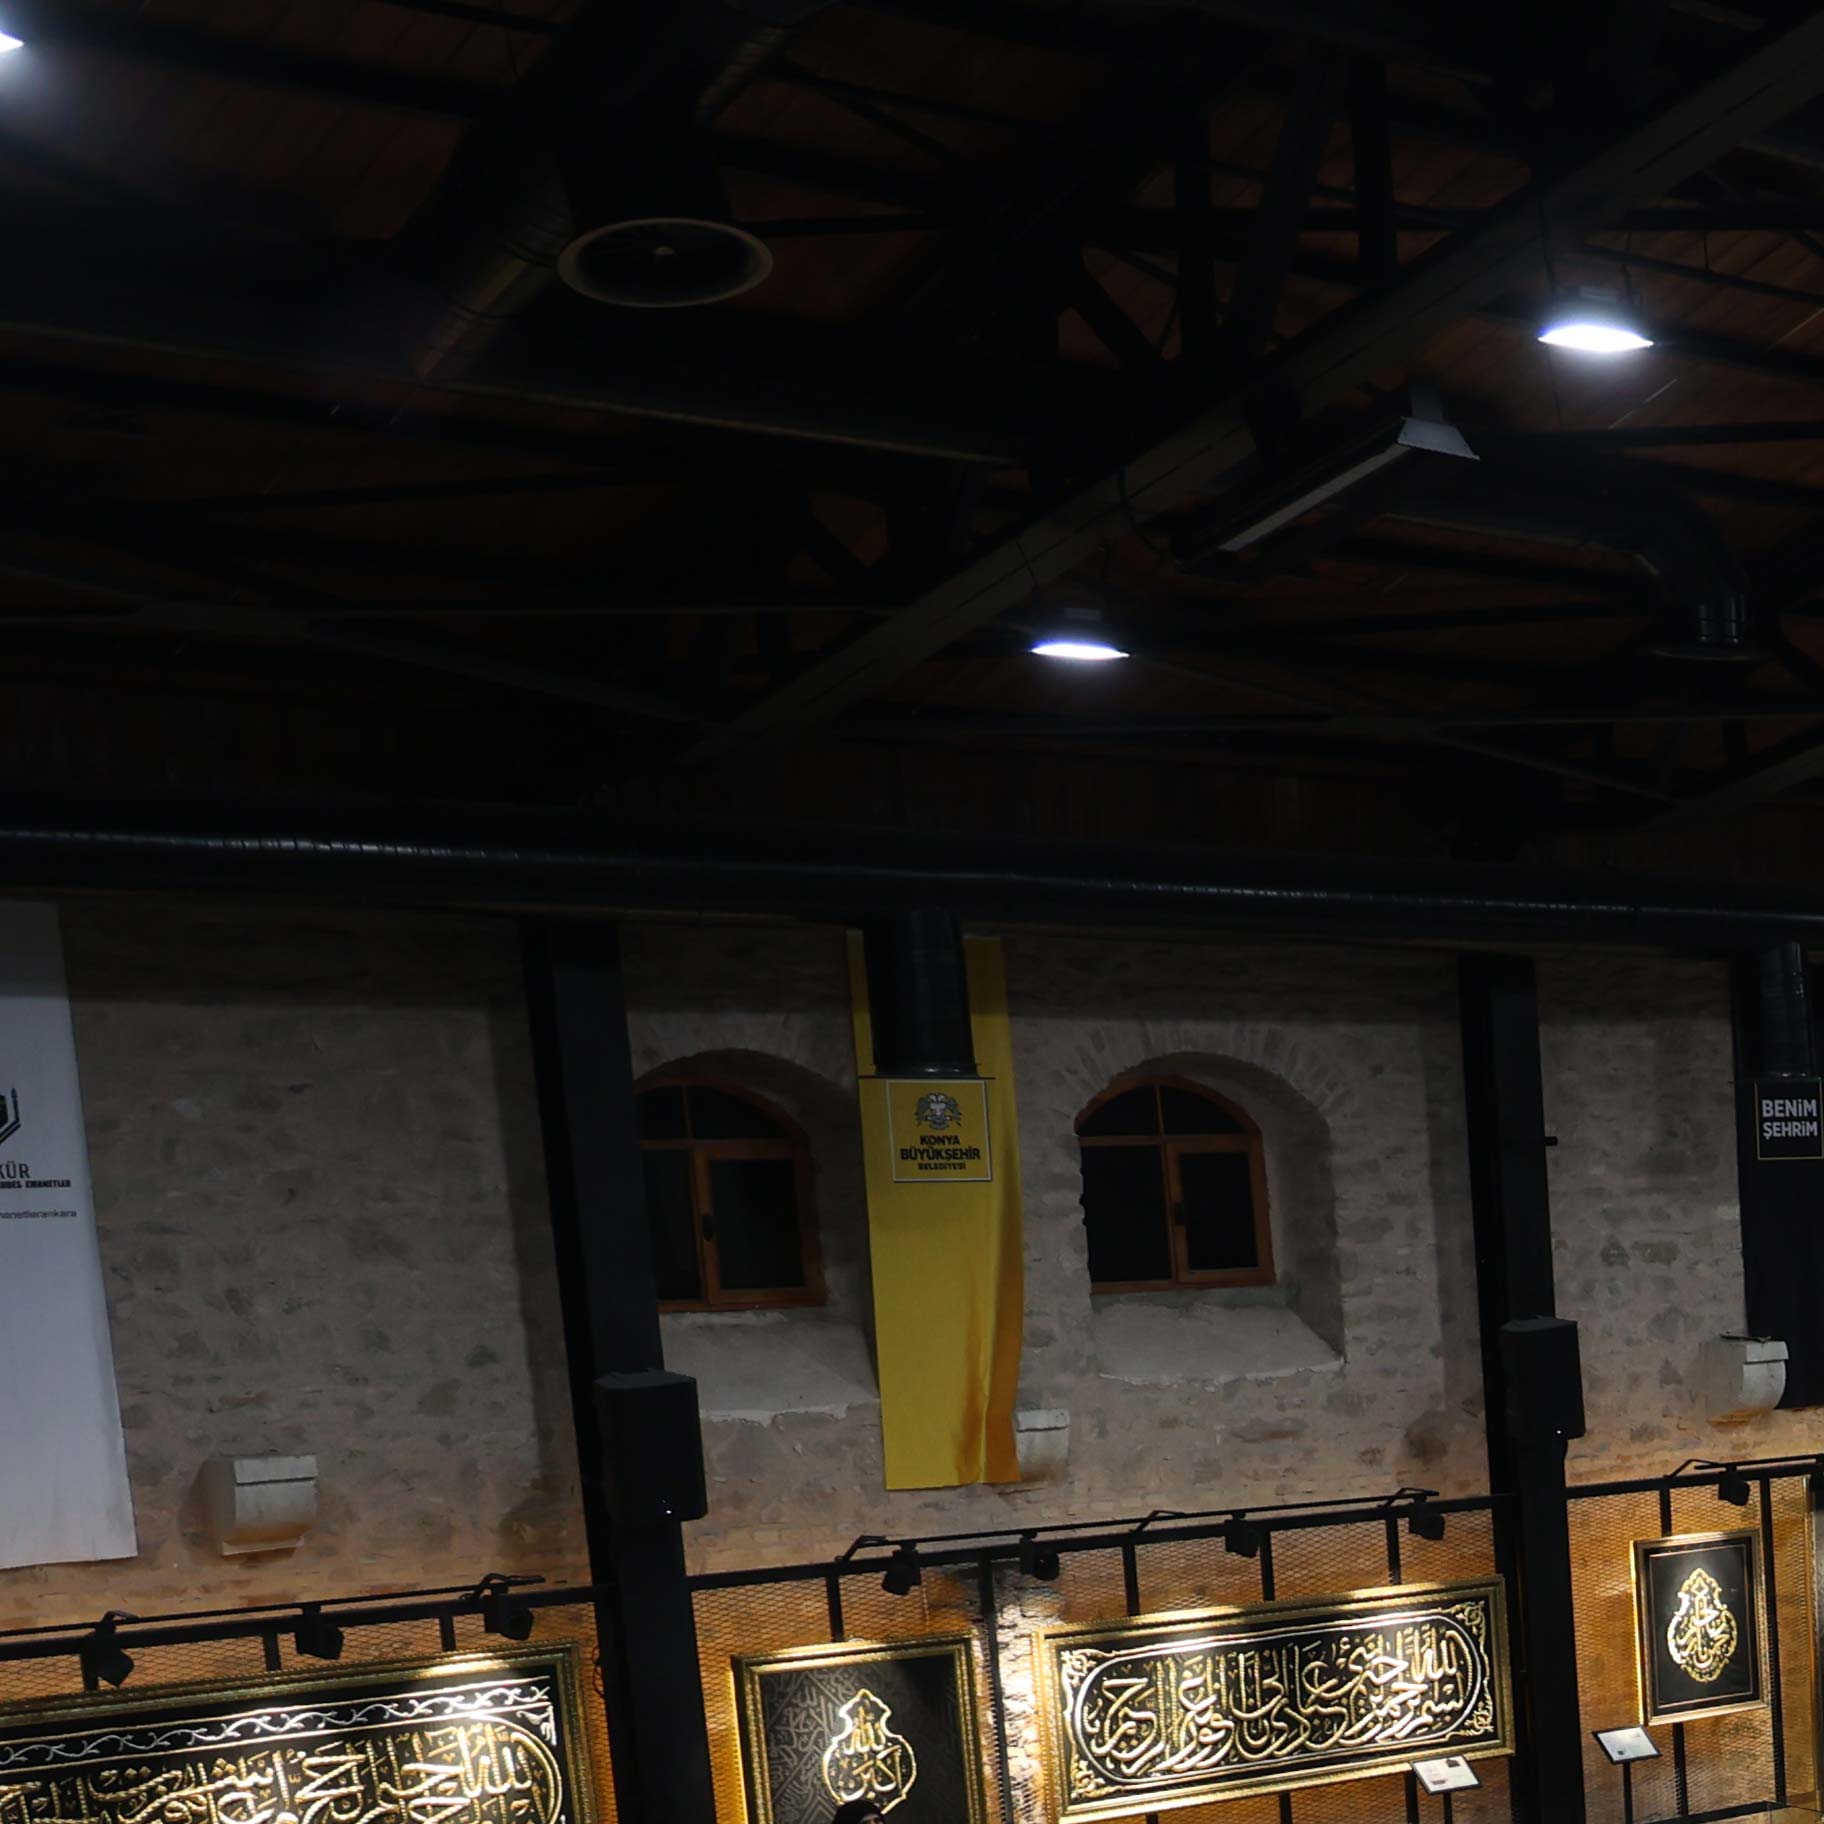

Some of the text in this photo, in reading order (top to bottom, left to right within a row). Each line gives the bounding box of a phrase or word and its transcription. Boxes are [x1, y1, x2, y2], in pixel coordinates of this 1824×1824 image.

[1761, 1098, 1818, 1118] BENİM
[1762, 1120, 1819, 1141] ŞEHRİM
[920, 1135, 961, 1146] KONYA
[900, 1145, 981, 1161] BÜYÜKŞEHİR
